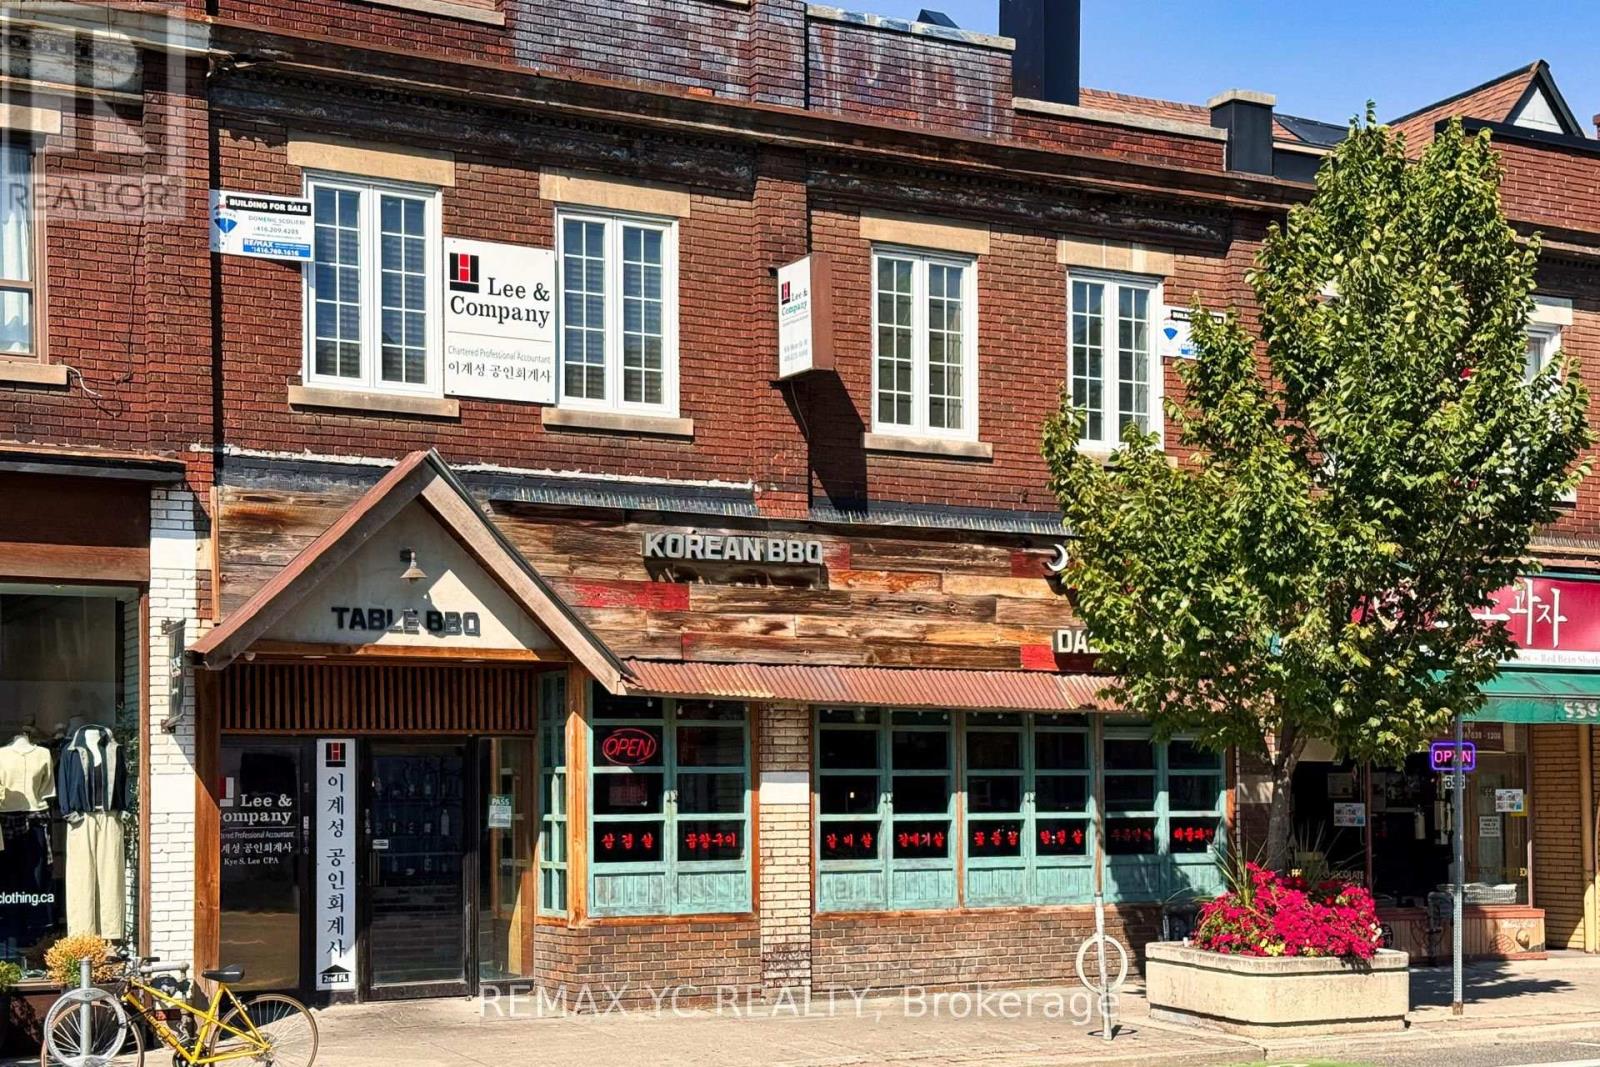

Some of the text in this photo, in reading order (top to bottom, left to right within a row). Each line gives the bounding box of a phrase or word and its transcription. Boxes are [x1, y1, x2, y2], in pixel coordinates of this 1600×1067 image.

[229, 198, 308, 213] BUILDING FOR SALE
[488, 277, 550, 302] Lee &
[450, 295, 551, 329] Company
[781, 301, 808, 317] Company
[448, 344, 551, 364] Chartered Professional Accountant
[448, 361, 553, 384] 이계성 공인회계사
[643, 532, 824, 566] KOREAN BBQ
[331, 606, 481, 638] TABLE BBQ
[604, 738, 652, 757] OPEN
[240, 793, 292, 807] Lee &
[491, 797, 510, 806] PASS
[222, 811, 292, 826] ompany
[235, 830, 265, 840] Professional
[265, 830, 294, 839] Accountant
[221, 841, 293, 855] 계성 공인회계사
[223, 857, 238, 867] Kye
[247, 857, 261, 865] Lee
[262, 856, 280, 865] CPA
[326, 772, 346, 959] 이계성 공인회계사
[323, 974, 338, 984] 2nd
